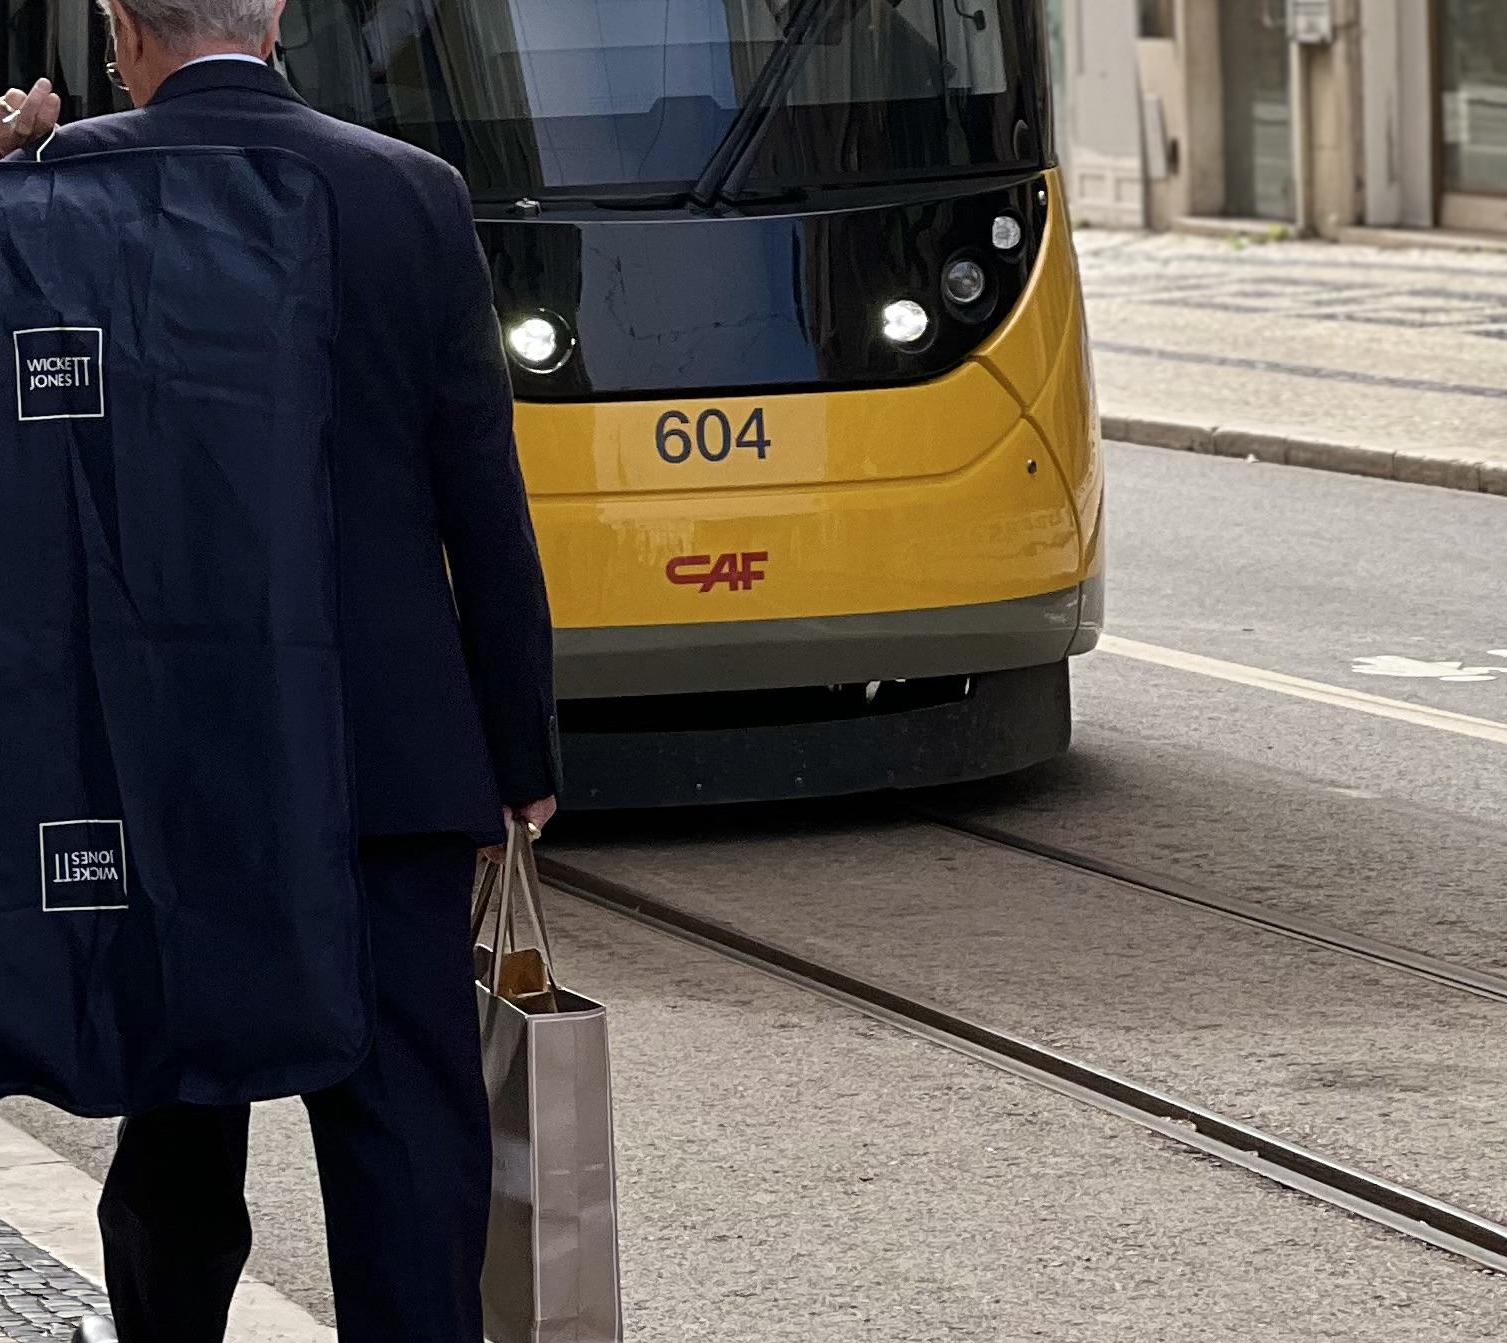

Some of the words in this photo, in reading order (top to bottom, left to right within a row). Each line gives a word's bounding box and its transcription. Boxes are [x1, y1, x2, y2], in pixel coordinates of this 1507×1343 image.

[26, 357, 91, 387] WICKETT
[29, 374, 73, 391] JONES
[655, 407, 771, 464] 604
[665, 551, 769, 593] CAF
[53, 852, 119, 883] WICKETT
[71, 849, 115, 865] JONES
